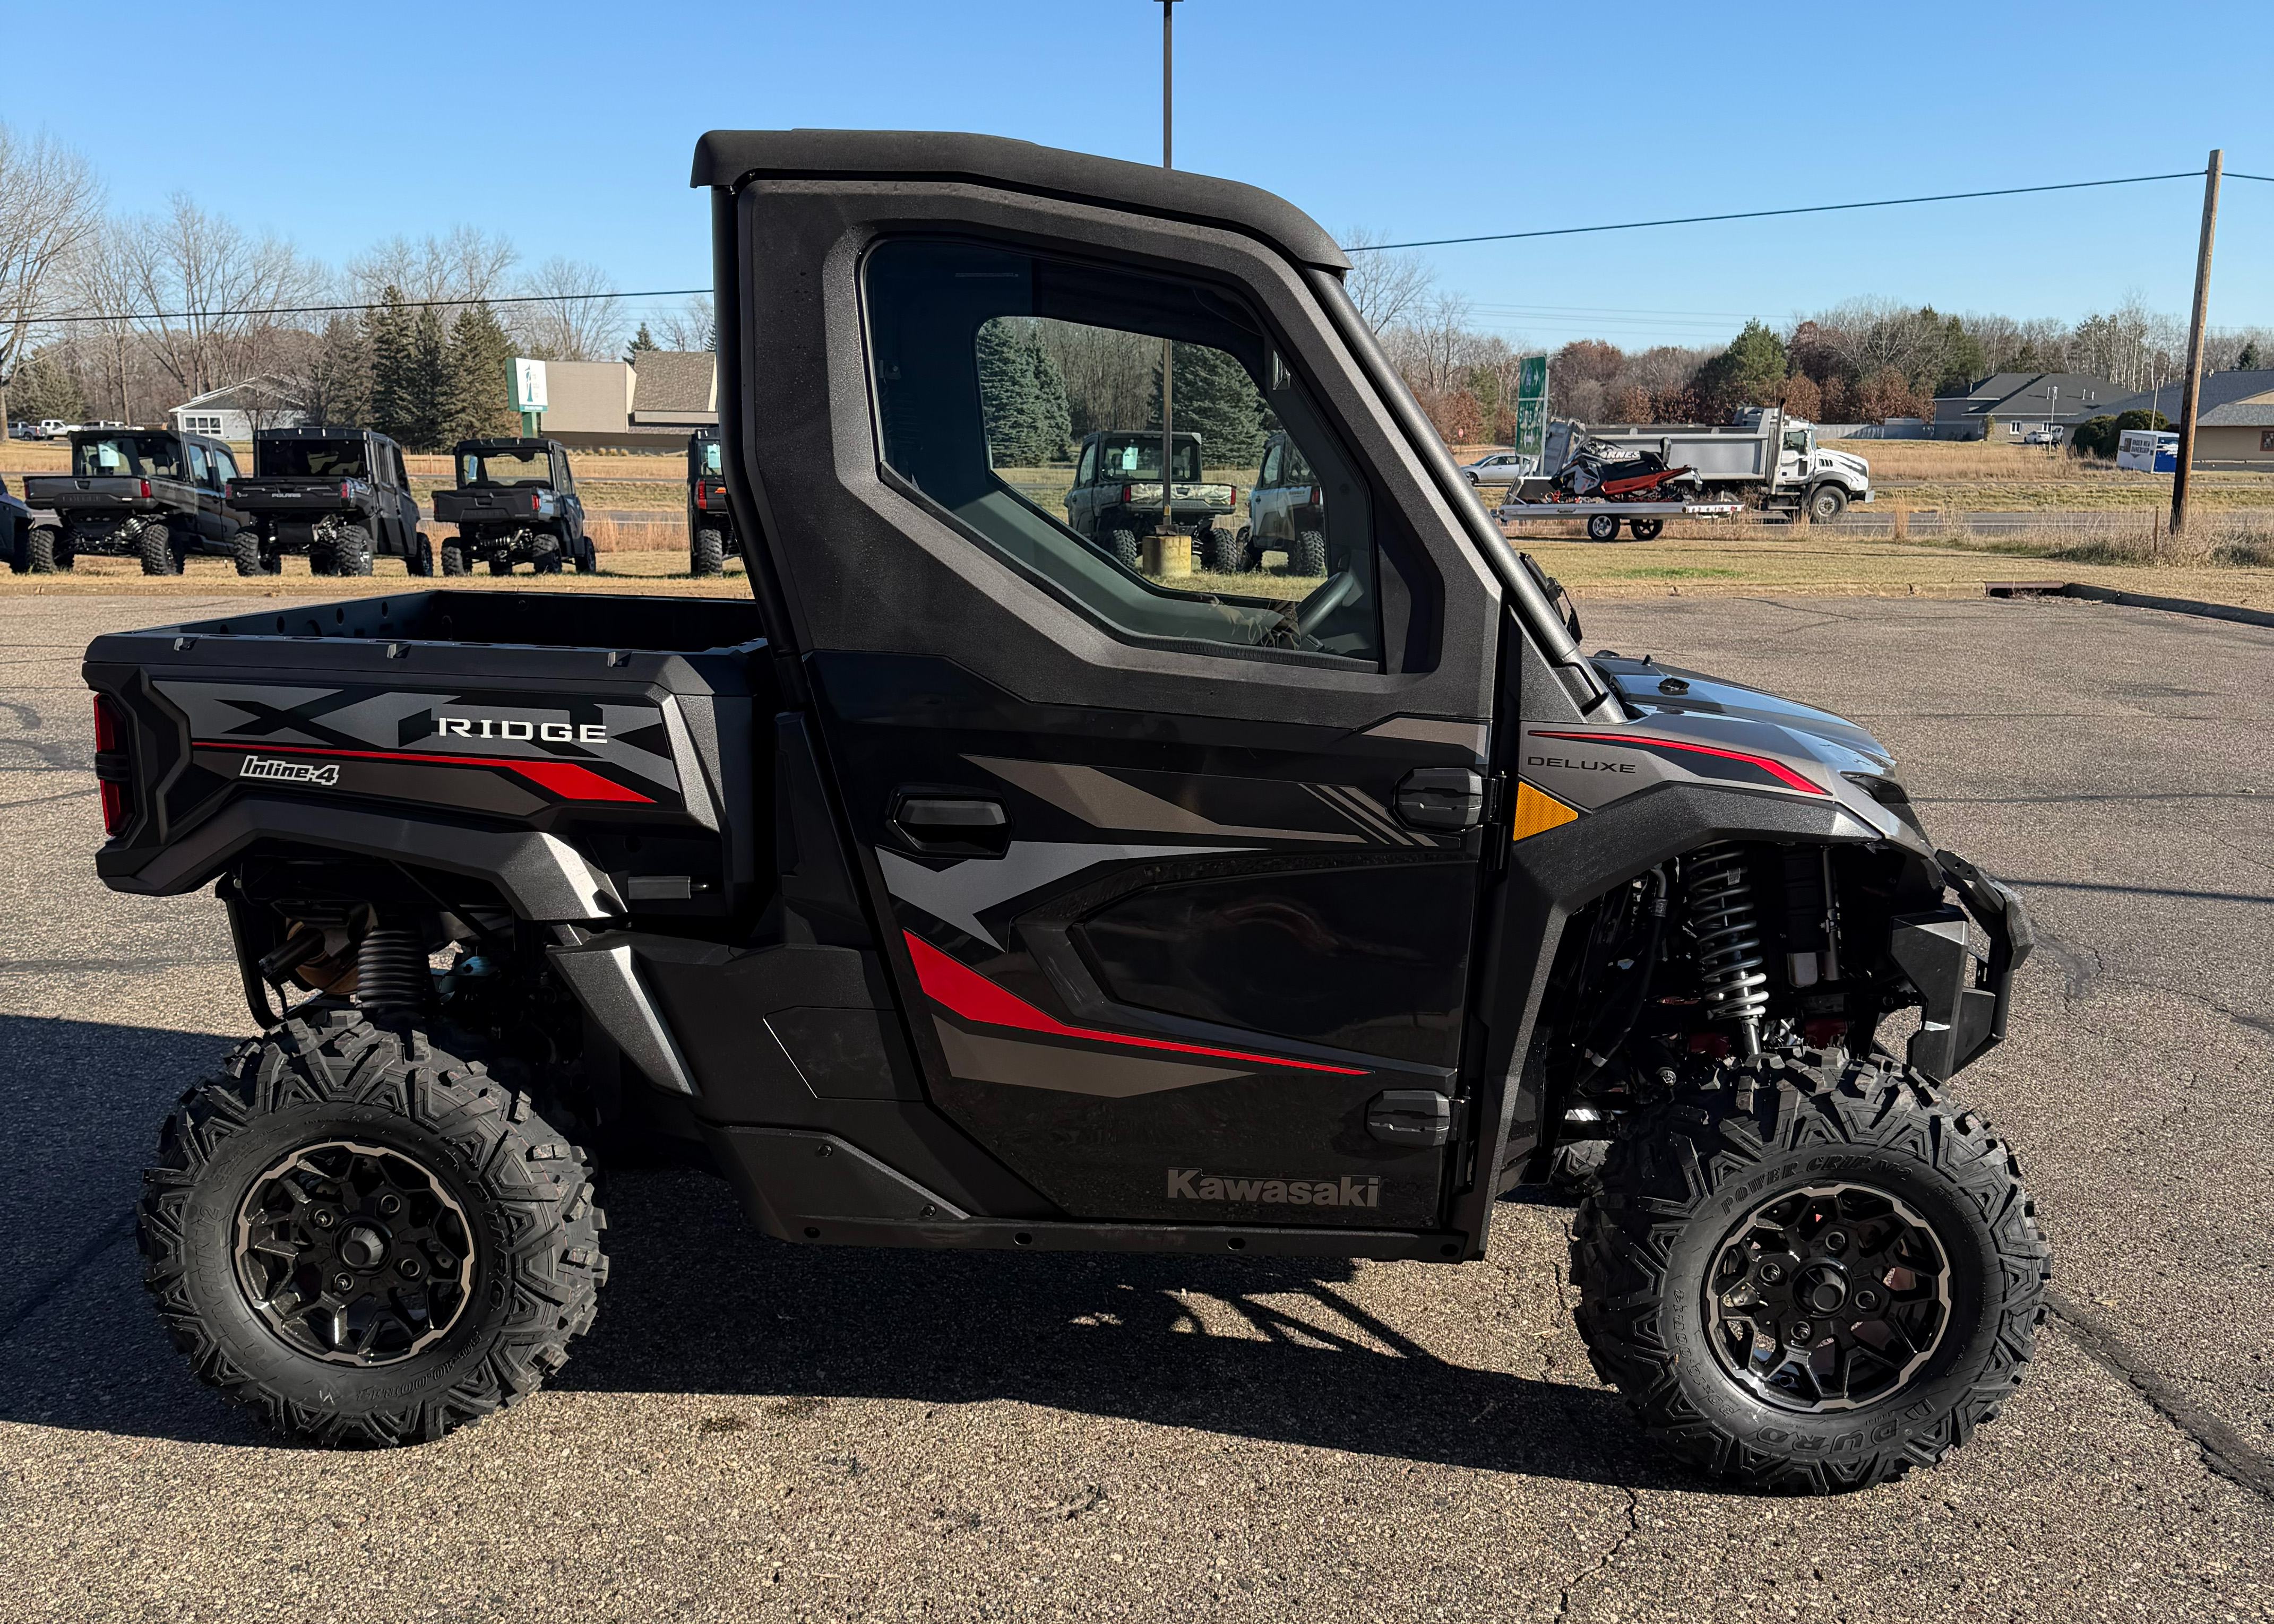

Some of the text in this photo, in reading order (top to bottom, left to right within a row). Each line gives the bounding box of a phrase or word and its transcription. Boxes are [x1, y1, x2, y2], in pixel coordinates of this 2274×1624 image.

[438, 718, 608, 744] RIDGE
[239, 755, 340, 786] Inline-4
[1527, 756, 1636, 774] DELUXE
[1167, 1169, 1380, 1208] Kawasaki
[1720, 1161, 1799, 1217] POWER
[1806, 1154, 1873, 1172] GRIP
[468, 1181, 508, 1311] DURO
[1756, 1418, 1899, 1454] DURO
